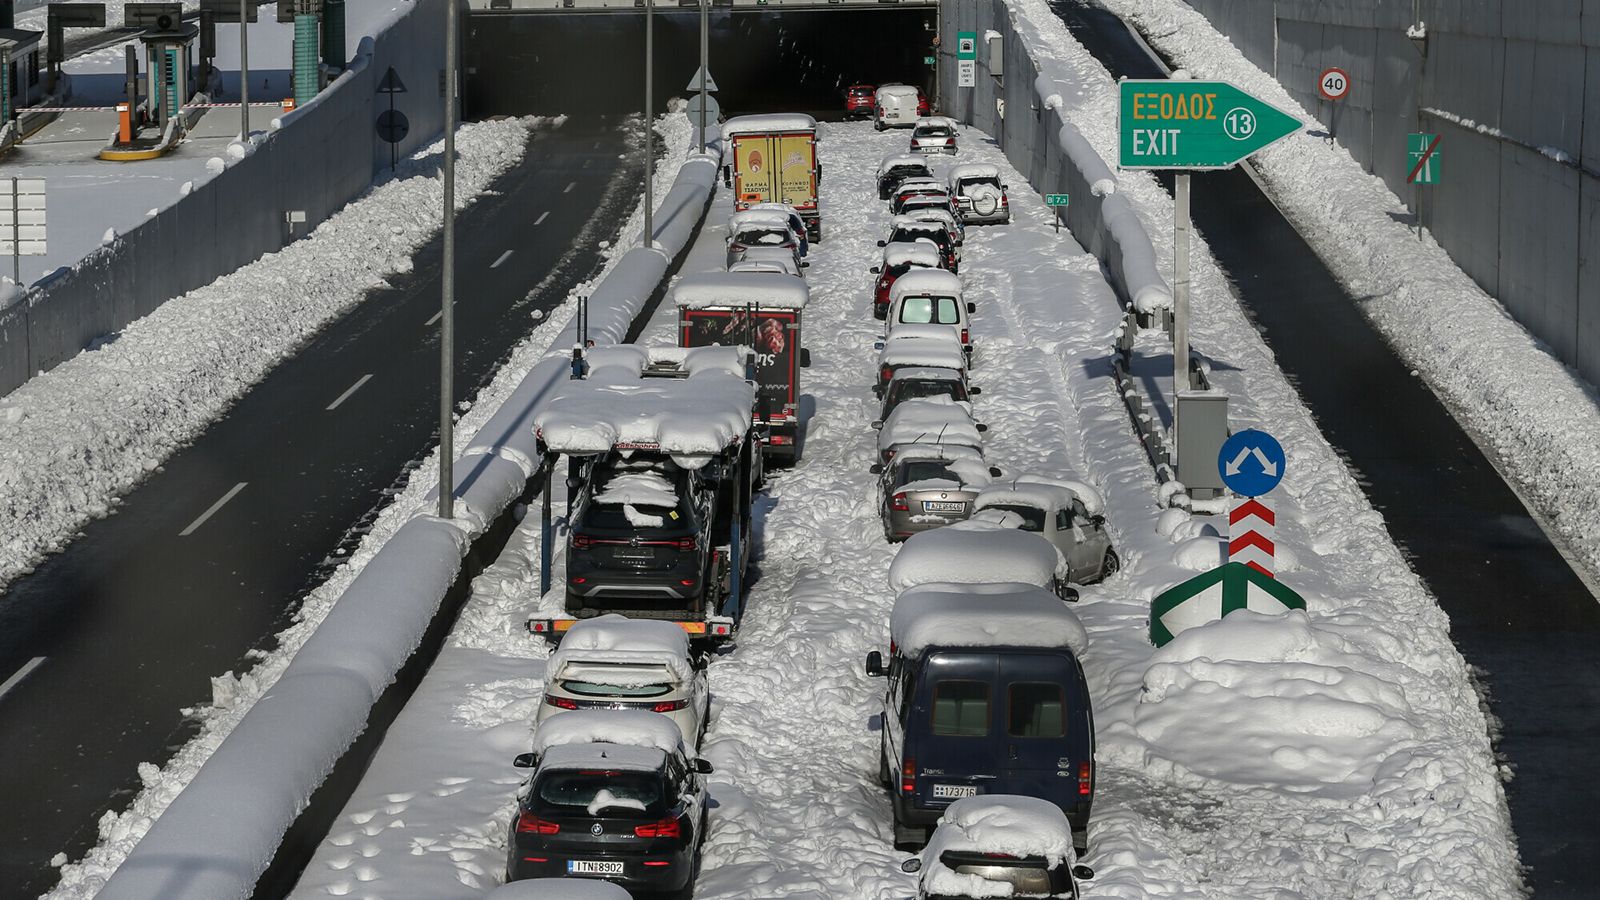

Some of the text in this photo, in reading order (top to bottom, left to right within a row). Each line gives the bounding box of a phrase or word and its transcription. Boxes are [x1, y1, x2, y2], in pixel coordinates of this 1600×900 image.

[1324, 78, 1343, 90] 40
[1133, 93, 1217, 120] ΕΞΟΔΟΣ
[1228, 113, 1252, 134] 13
[1133, 129, 1181, 156] EXIT
[944, 786, 975, 797] 173716
